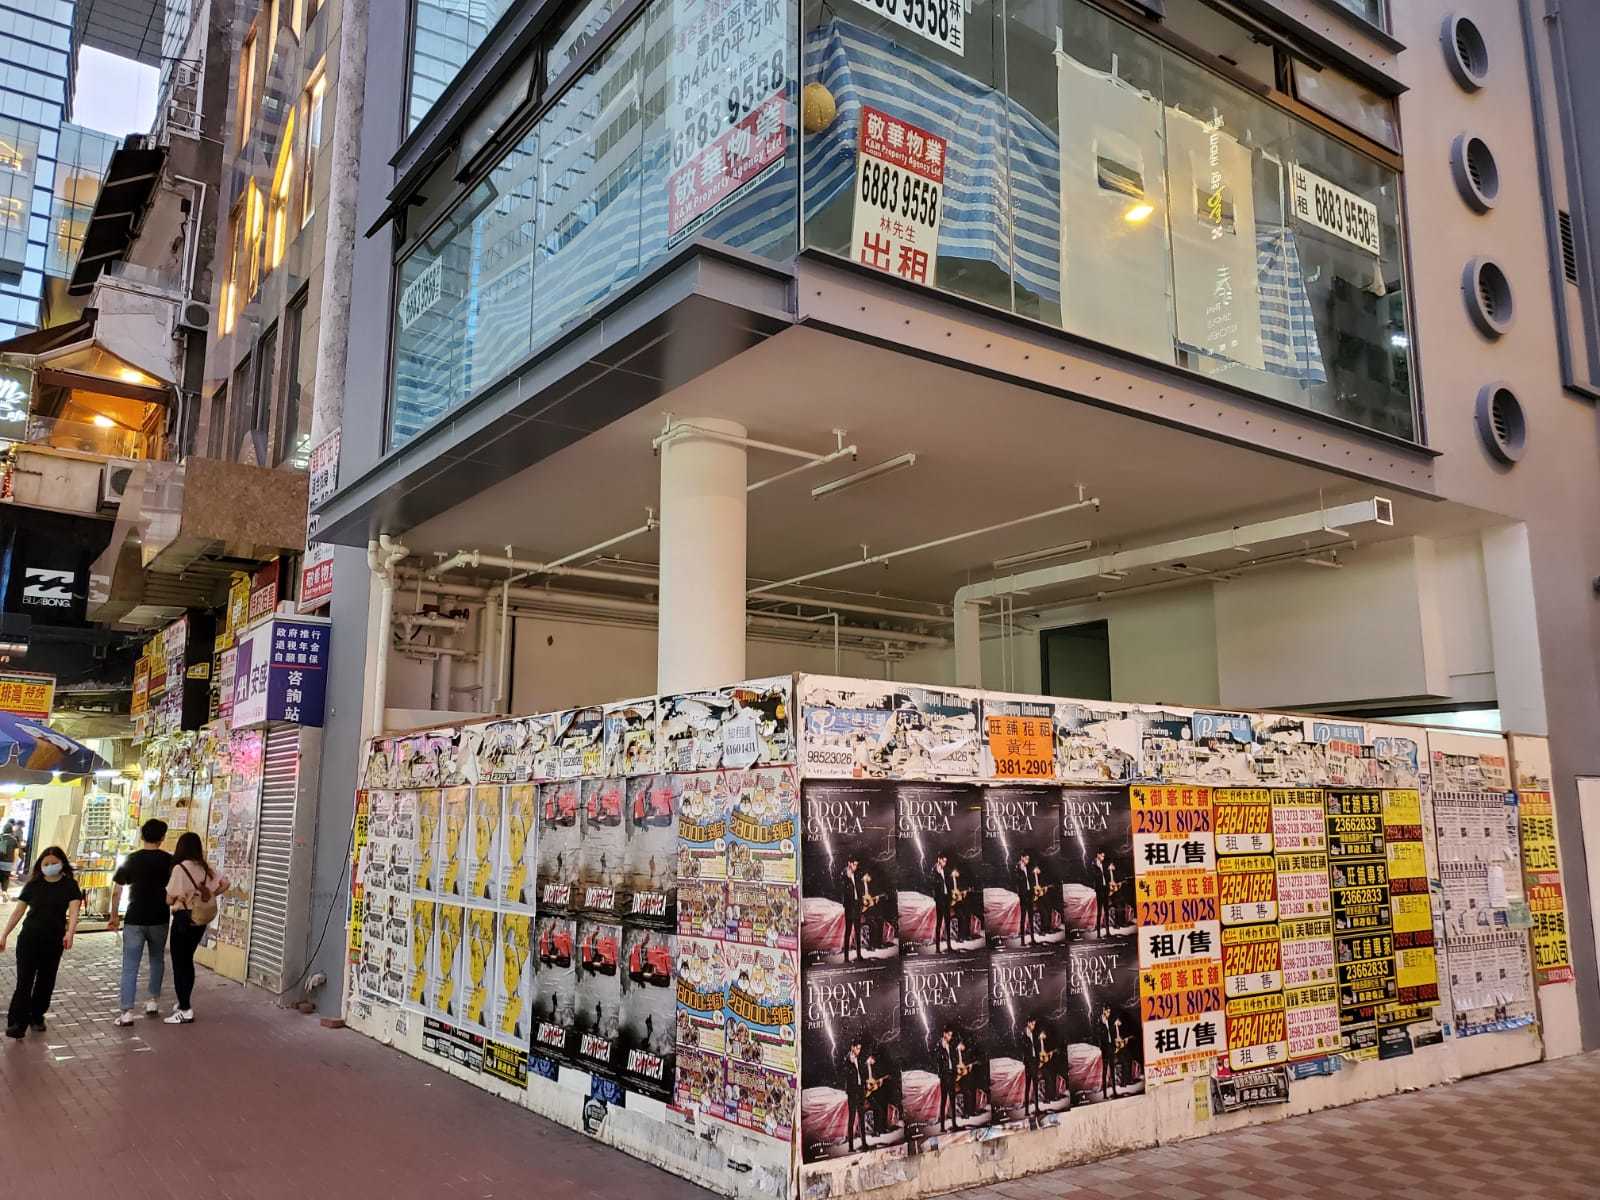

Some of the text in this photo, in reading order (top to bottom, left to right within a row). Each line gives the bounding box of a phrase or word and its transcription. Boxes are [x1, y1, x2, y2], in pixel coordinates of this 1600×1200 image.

[728, 48, 784, 124] 9558
[931, 163, 942, 178] Ltd
[862, 159, 938, 228] 6883 9558
[1315, 183, 1371, 246] 6883 9558
[880, 216, 916, 244] 林先生
[861, 231, 929, 284] 出租
[276, 627, 321, 640] 政府推行
[1522, 792, 1547, 804] TML
[817, 800, 870, 818] DON'T
[909, 800, 958, 817] DON'T
[995, 801, 1039, 817] DON'T
[1072, 801, 1112, 816] DON'T
[807, 816, 864, 834] GIVE A
[899, 815, 952, 832] GIVE A
[986, 816, 1033, 831] GIVE A
[1063, 815, 1108, 830] GIVE A
[1137, 809, 1210, 833] 2391 8028
[1335, 817, 1377, 832] 23662833
[1144, 841, 1207, 866] 租/售
[1340, 888, 1382, 905] 23662833
[1531, 886, 1559, 898] TML
[1142, 897, 1216, 926] 2391 8028
[1149, 930, 1212, 959] 租/售
[1001, 963, 1046, 983] DON'T
[1079, 954, 1120, 973] DON'T
[1345, 960, 1389, 980] 23662833
[914, 970, 965, 992] DON'T
[1070, 968, 1115, 988] GIVE A
[819, 980, 874, 1003] DON'T
[904, 987, 958, 1008] GIVE A
[993, 979, 1040, 999] GIVE A
[808, 997, 867, 1021] GIVE A
[1147, 987, 1221, 1021] 2391 8028
[1154, 1021, 1217, 1054] 租/售
